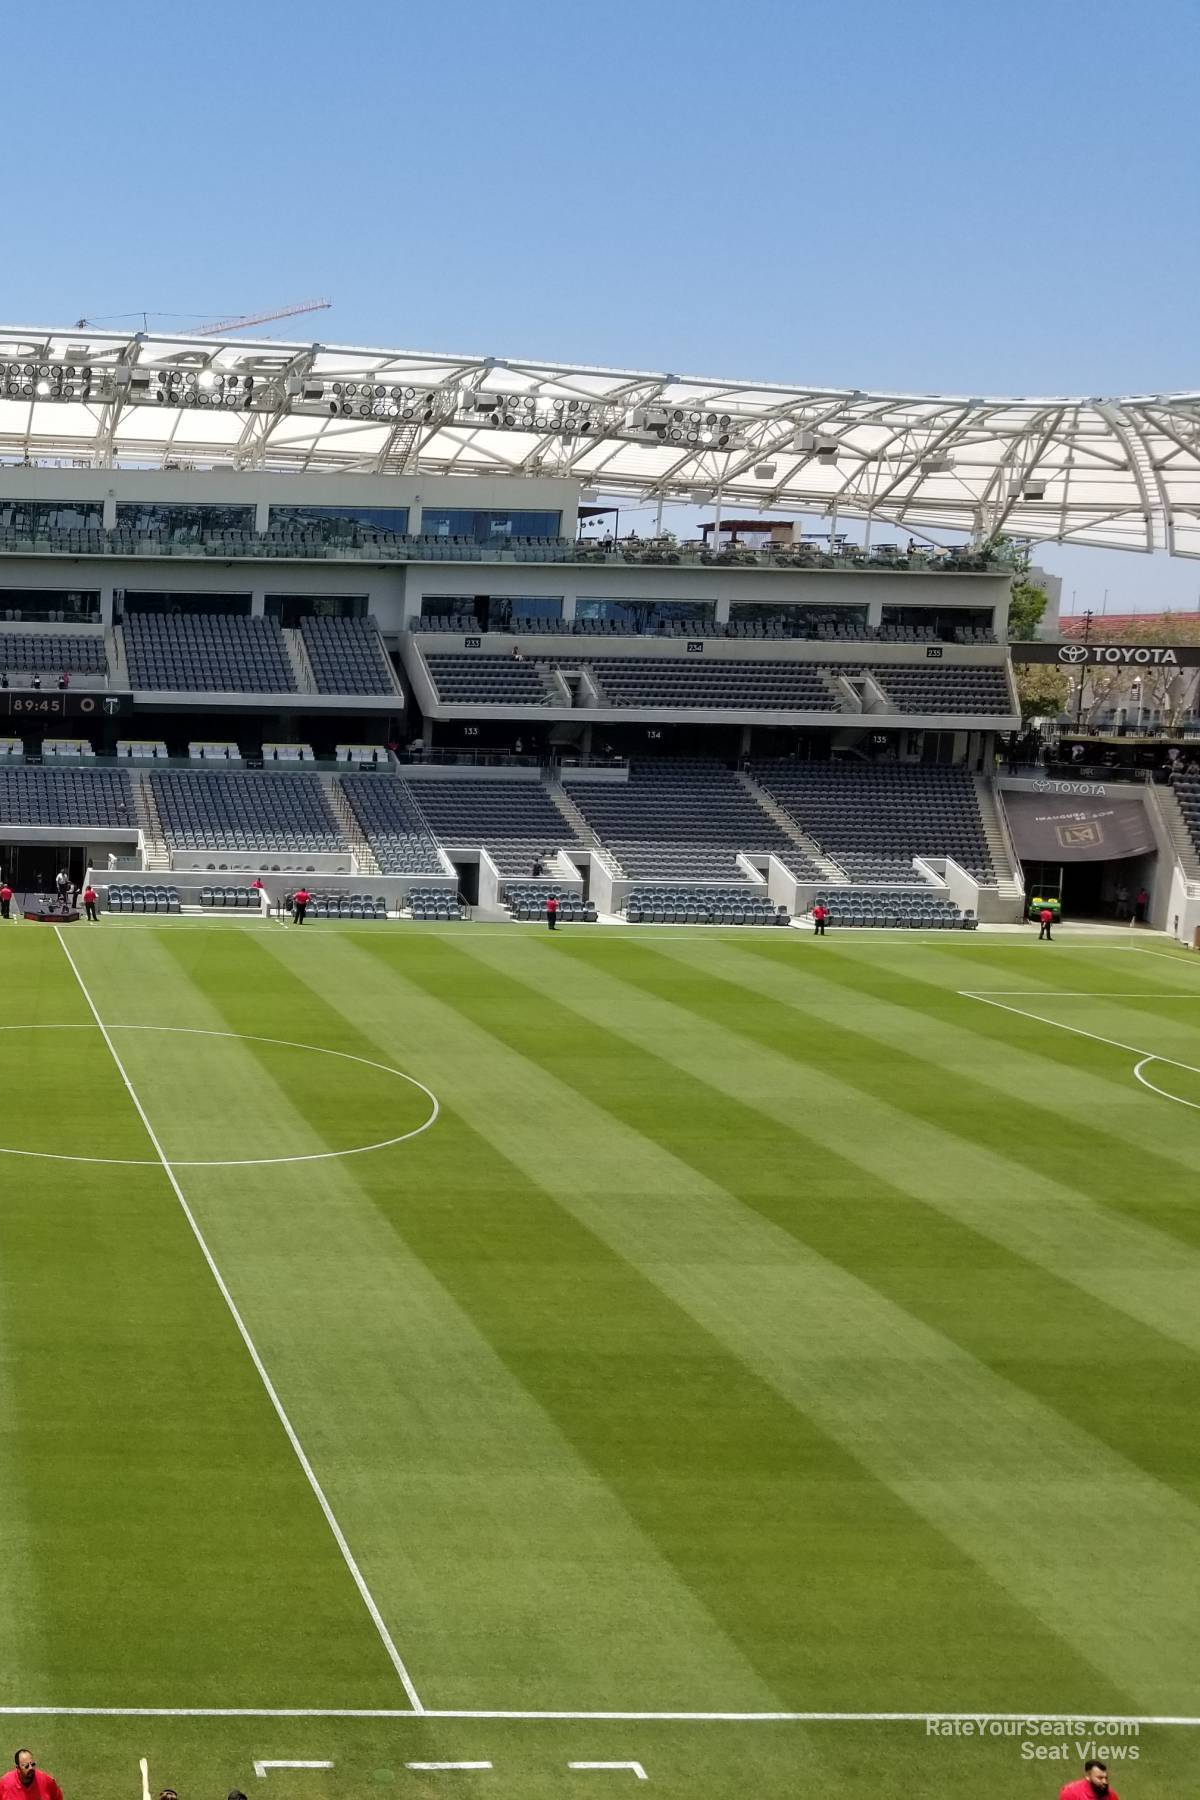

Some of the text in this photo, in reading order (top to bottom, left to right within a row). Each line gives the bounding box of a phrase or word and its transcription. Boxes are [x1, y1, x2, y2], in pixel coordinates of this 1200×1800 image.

[465, 639, 480, 647] 233
[688, 643, 702, 652] 234
[927, 649, 942, 658] 235
[1092, 648, 1177, 664] TOYOTA
[13, 700, 61, 712] 89:45
[464, 727, 478, 735] 133
[648, 731, 661, 739] 134
[873, 735, 887, 744] 135
[1053, 782, 1106, 796] TOYOTA
[1035, 812, 1086, 822] INAUGURA
